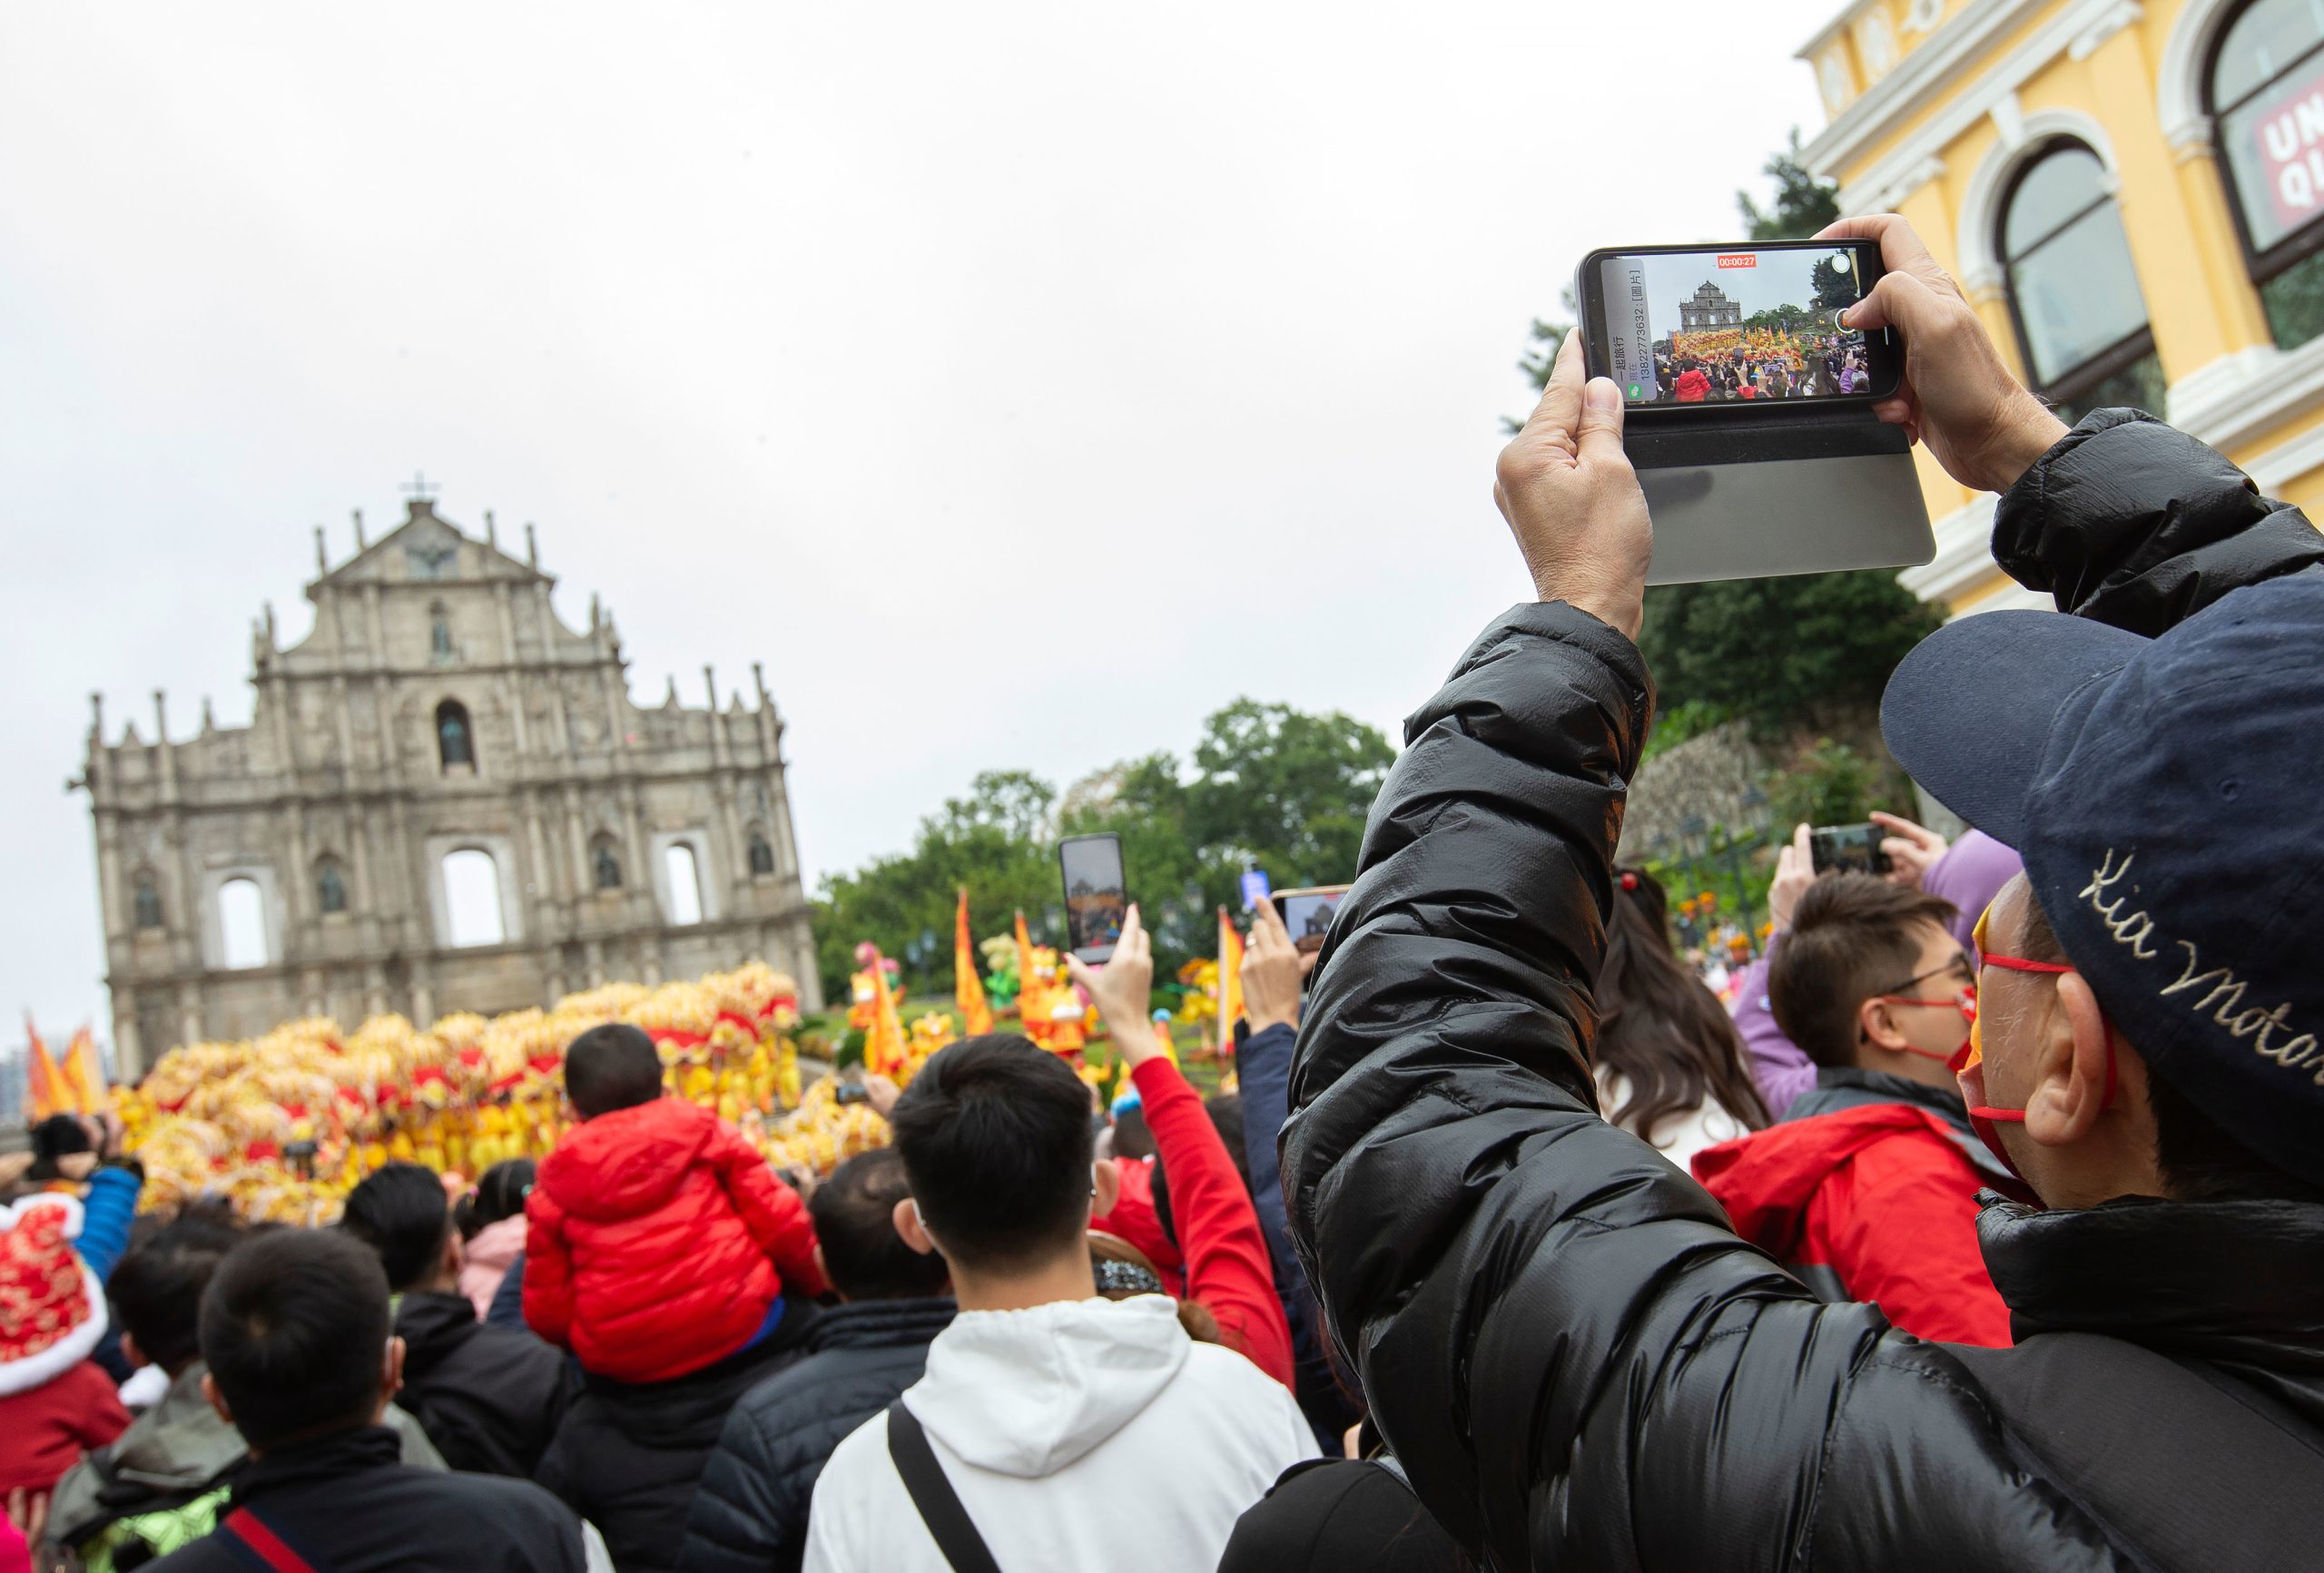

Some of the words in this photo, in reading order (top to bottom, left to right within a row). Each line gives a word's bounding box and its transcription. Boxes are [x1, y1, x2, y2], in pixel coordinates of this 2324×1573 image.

[1719, 258, 1754, 266] 00:00:27
[1613, 336, 1626, 380] 一起旅行
[2078, 848, 2157, 959] Kia
